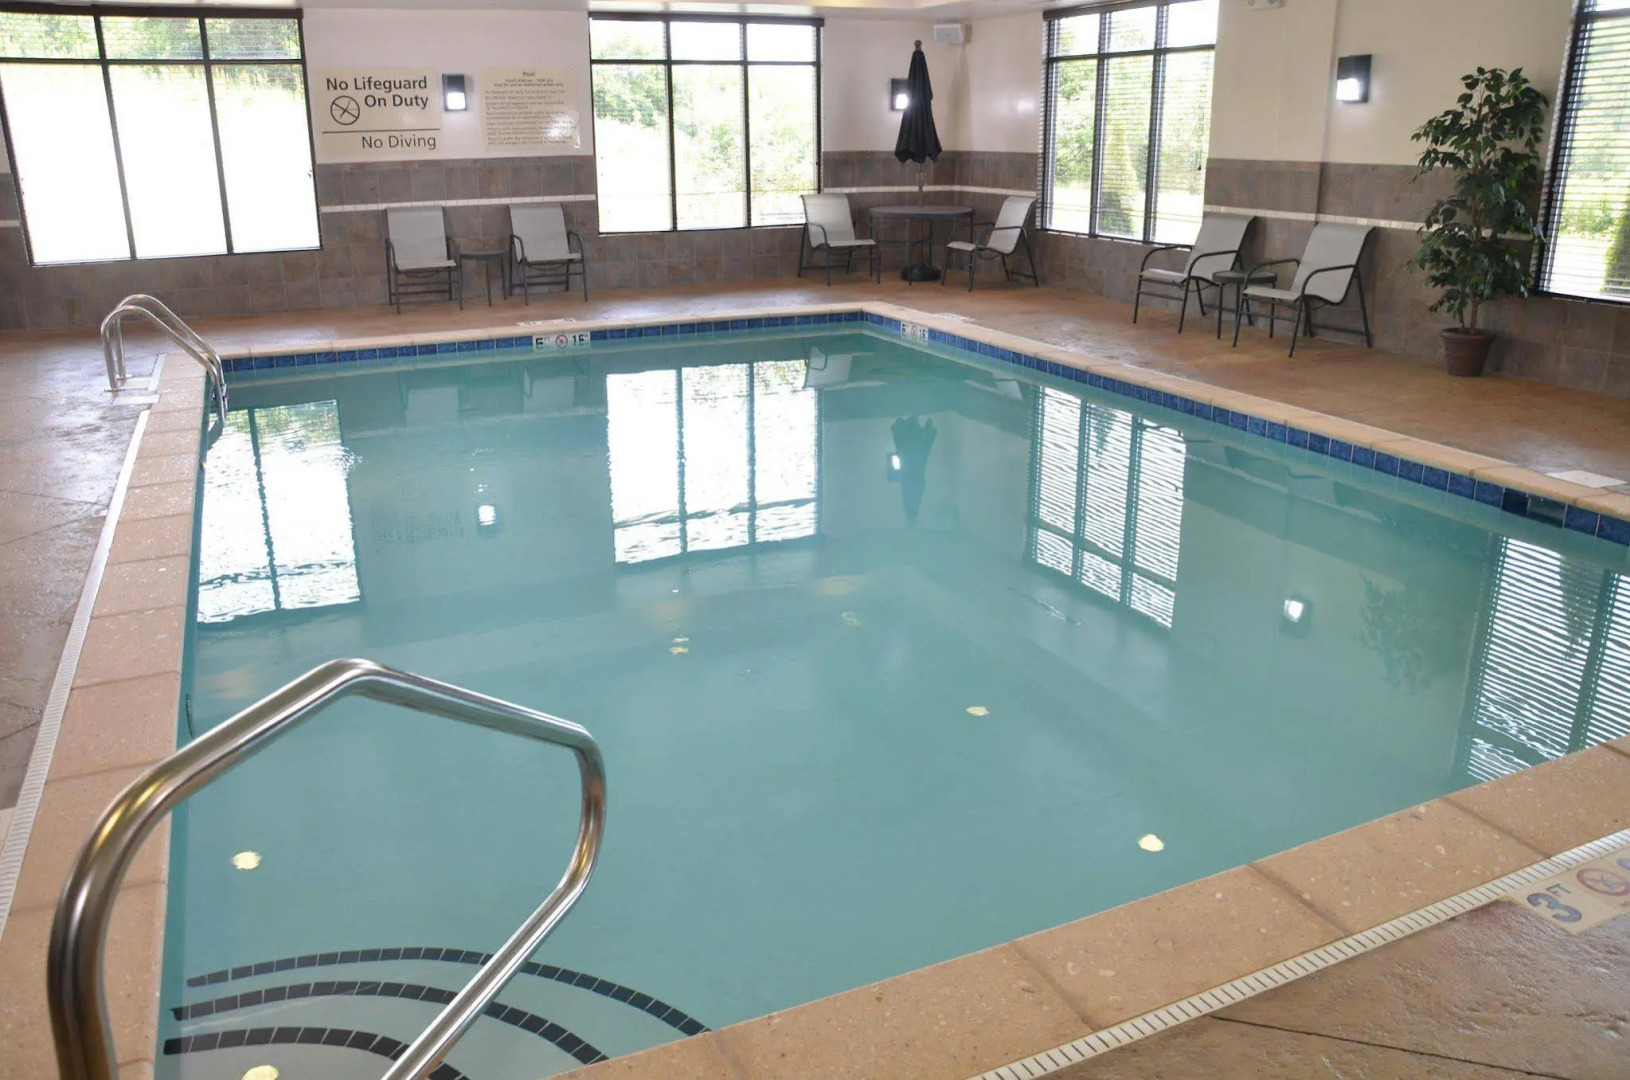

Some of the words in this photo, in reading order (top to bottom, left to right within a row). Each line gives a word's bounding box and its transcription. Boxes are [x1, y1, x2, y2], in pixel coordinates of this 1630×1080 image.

[326, 78, 348, 90] No
[354, 75, 427, 93] Lifeguard
[364, 94, 387, 107] On
[392, 94, 428, 110] Duty
[362, 136, 383, 148] No
[388, 134, 436, 150] Diving
[1545, 883, 1572, 898] FT
[1527, 892, 1582, 922] 3
